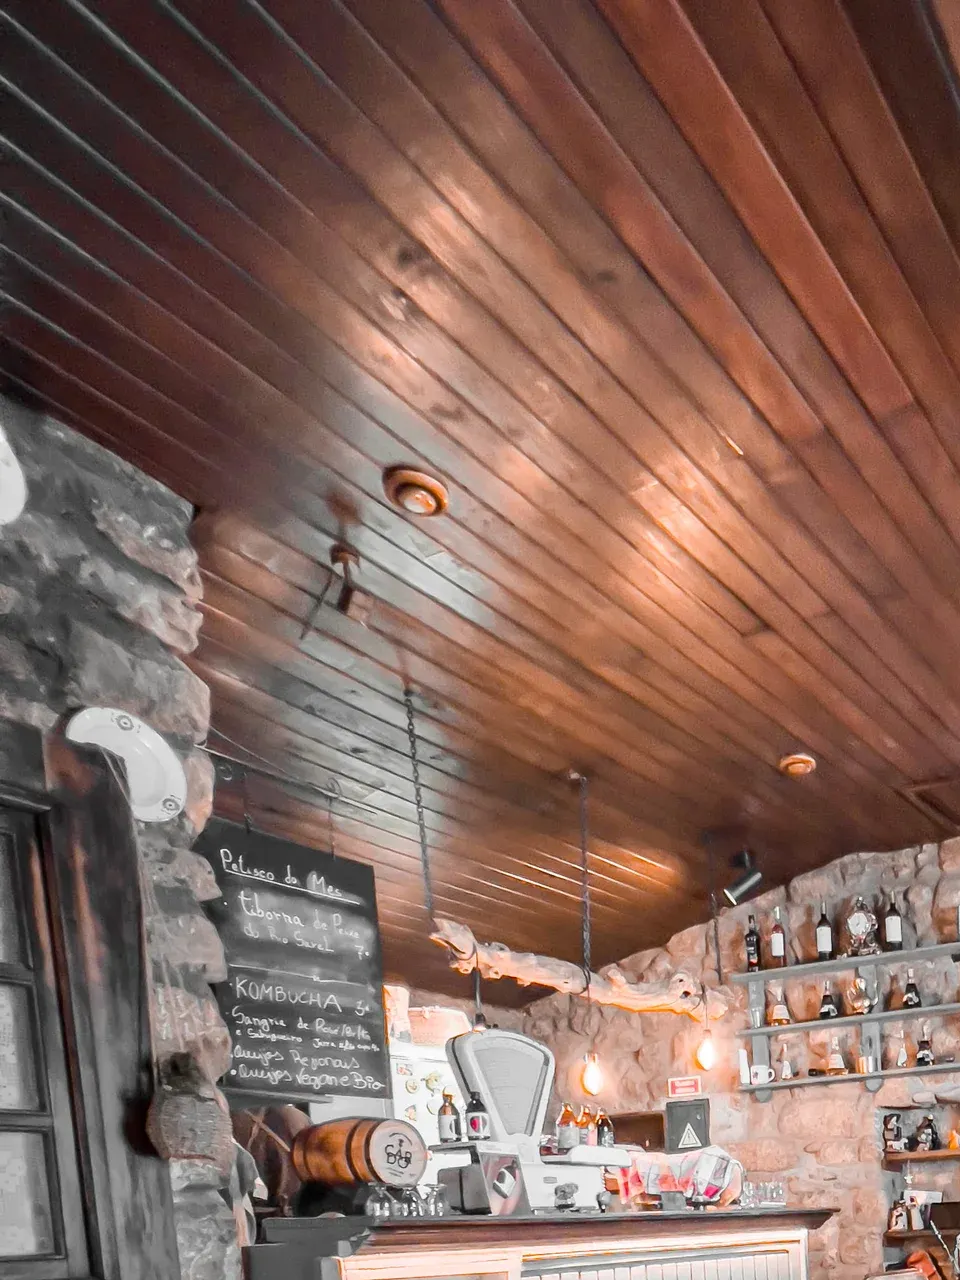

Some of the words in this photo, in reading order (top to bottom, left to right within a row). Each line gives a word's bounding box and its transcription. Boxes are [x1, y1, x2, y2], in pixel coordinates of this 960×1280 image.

[220, 848, 275, 881] Petisco
[285, 864, 298, 884] do
[313, 908, 328, 931] de
[243, 922, 260, 939] do
[266, 925, 289, 944] Rio
[235, 976, 343, 1013] KOMBUCHA
[297, 1016, 310, 1030] de
[349, 1071, 386, 1090] Bio
